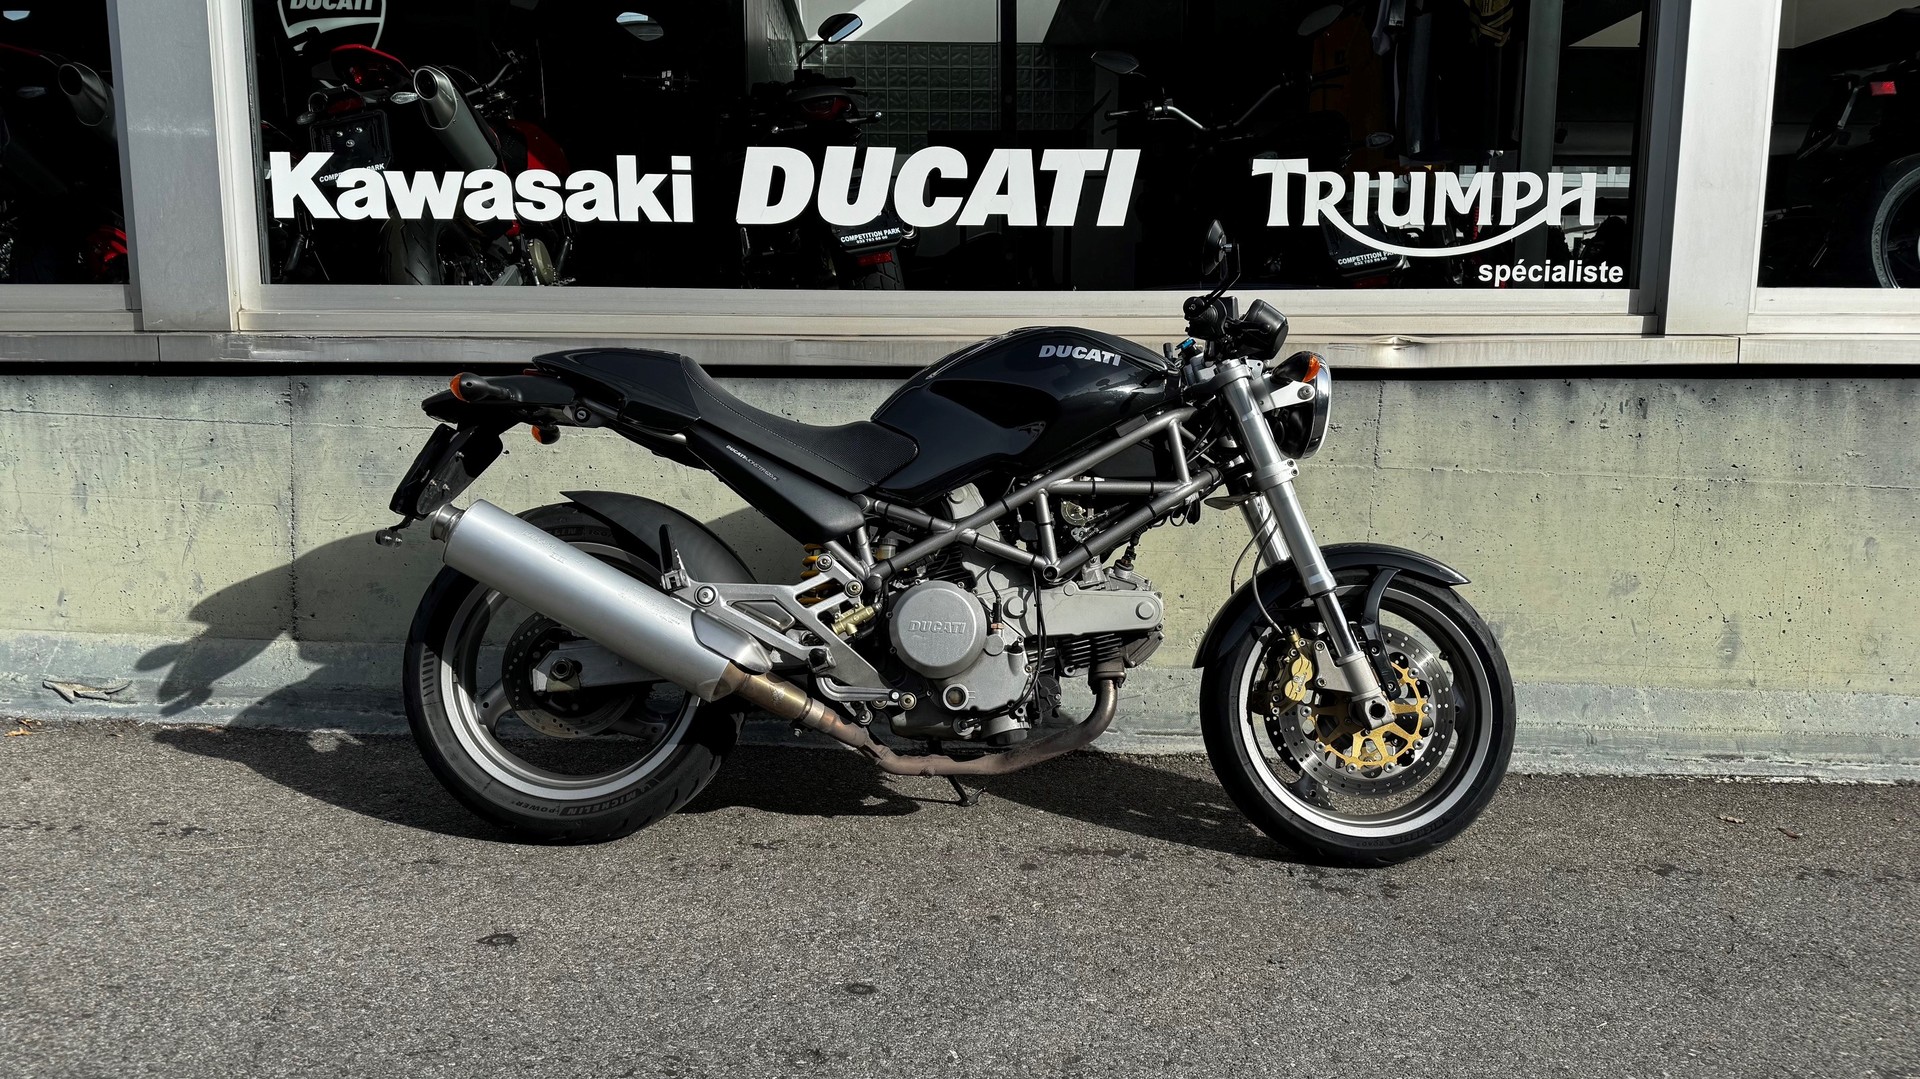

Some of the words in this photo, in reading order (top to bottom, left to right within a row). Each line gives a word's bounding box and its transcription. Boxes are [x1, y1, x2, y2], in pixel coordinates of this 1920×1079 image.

[269, 151, 693, 223] Kawasaki
[736, 146, 1141, 227] DUCATI
[1252, 158, 1597, 256] TRIUMPH
[840, 230, 883, 243] COMPETITION
[883, 227, 901, 236] PARK
[1337, 251, 1382, 266] COMPETITION
[1478, 258, 1624, 284] spécialiste
[1038, 344, 1121, 367] DUCATI
[908, 620, 967, 635] DUCATI
[567, 790, 638, 816] MICHELIN
